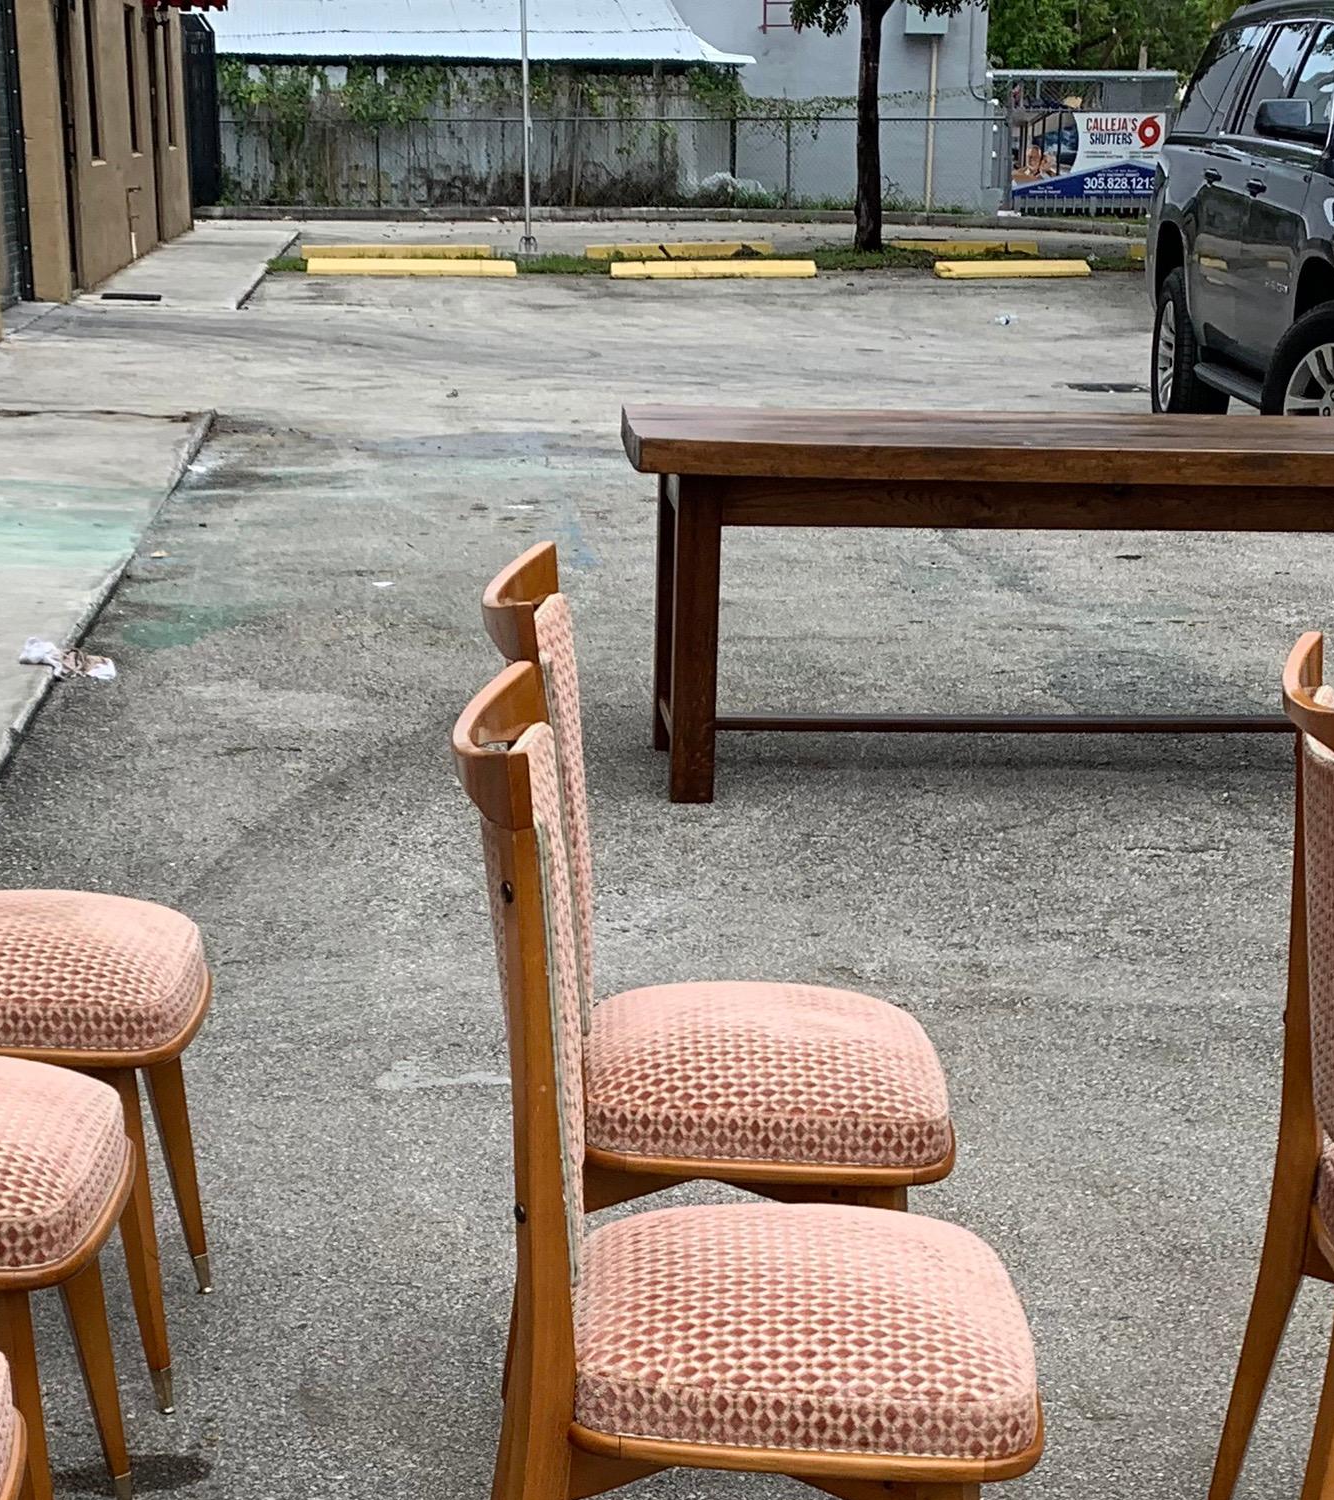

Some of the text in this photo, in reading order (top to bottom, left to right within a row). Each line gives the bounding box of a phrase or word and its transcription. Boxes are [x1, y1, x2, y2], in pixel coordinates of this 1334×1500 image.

[1086, 118, 1138, 132] CALLEJA'S
[1089, 133, 1133, 145] SHUTTERS
[1083, 177, 1155, 189] 305.828.1213
